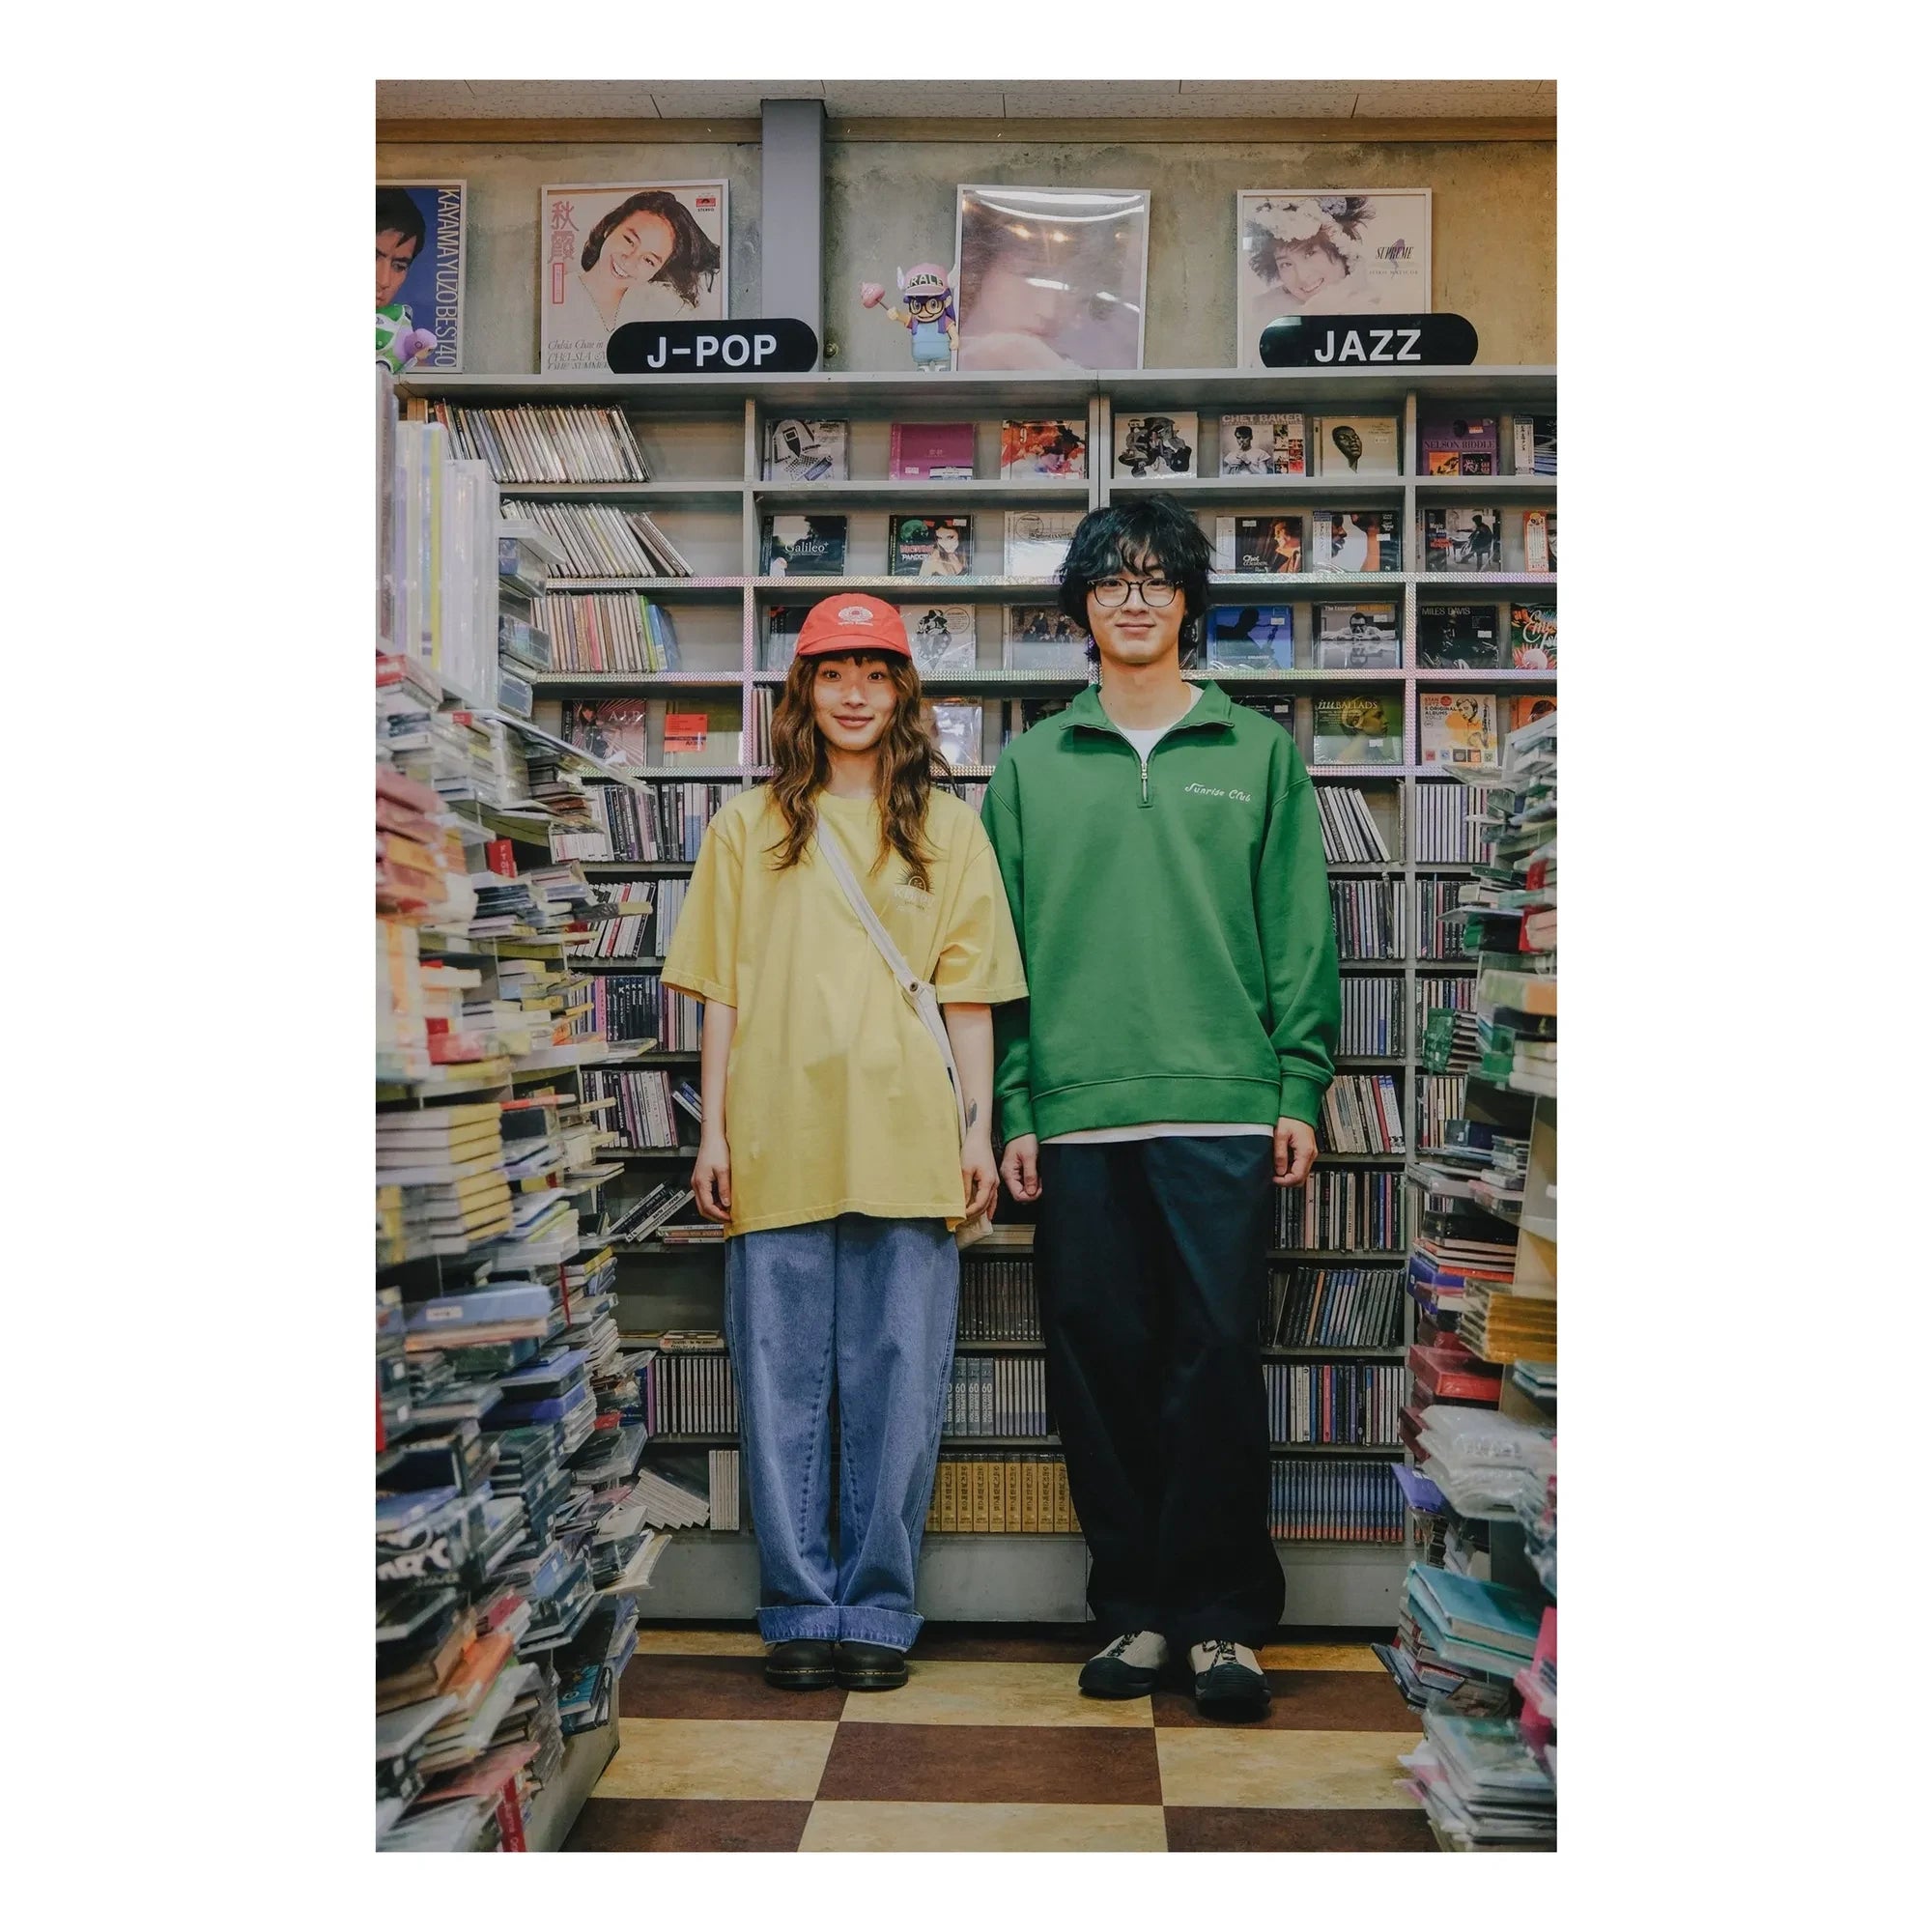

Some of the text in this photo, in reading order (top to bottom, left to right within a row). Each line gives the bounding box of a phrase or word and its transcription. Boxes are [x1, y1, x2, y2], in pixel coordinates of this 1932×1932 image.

[1375, 246, 1414, 260] SUPREME
[1314, 328, 1422, 363] JAZZ
[646, 334, 778, 369] J-POP
[1221, 412, 1303, 423] CHET BAKER
[1424, 440, 1461, 449] NELSON
[1421, 607, 1471, 616] MILES DAVIS
[1184, 782, 1252, 803] Sunrise Club
[955, 1383, 966, 1393] 60
[968, 1383, 979, 1393] 60
[982, 1383, 992, 1393] 60
